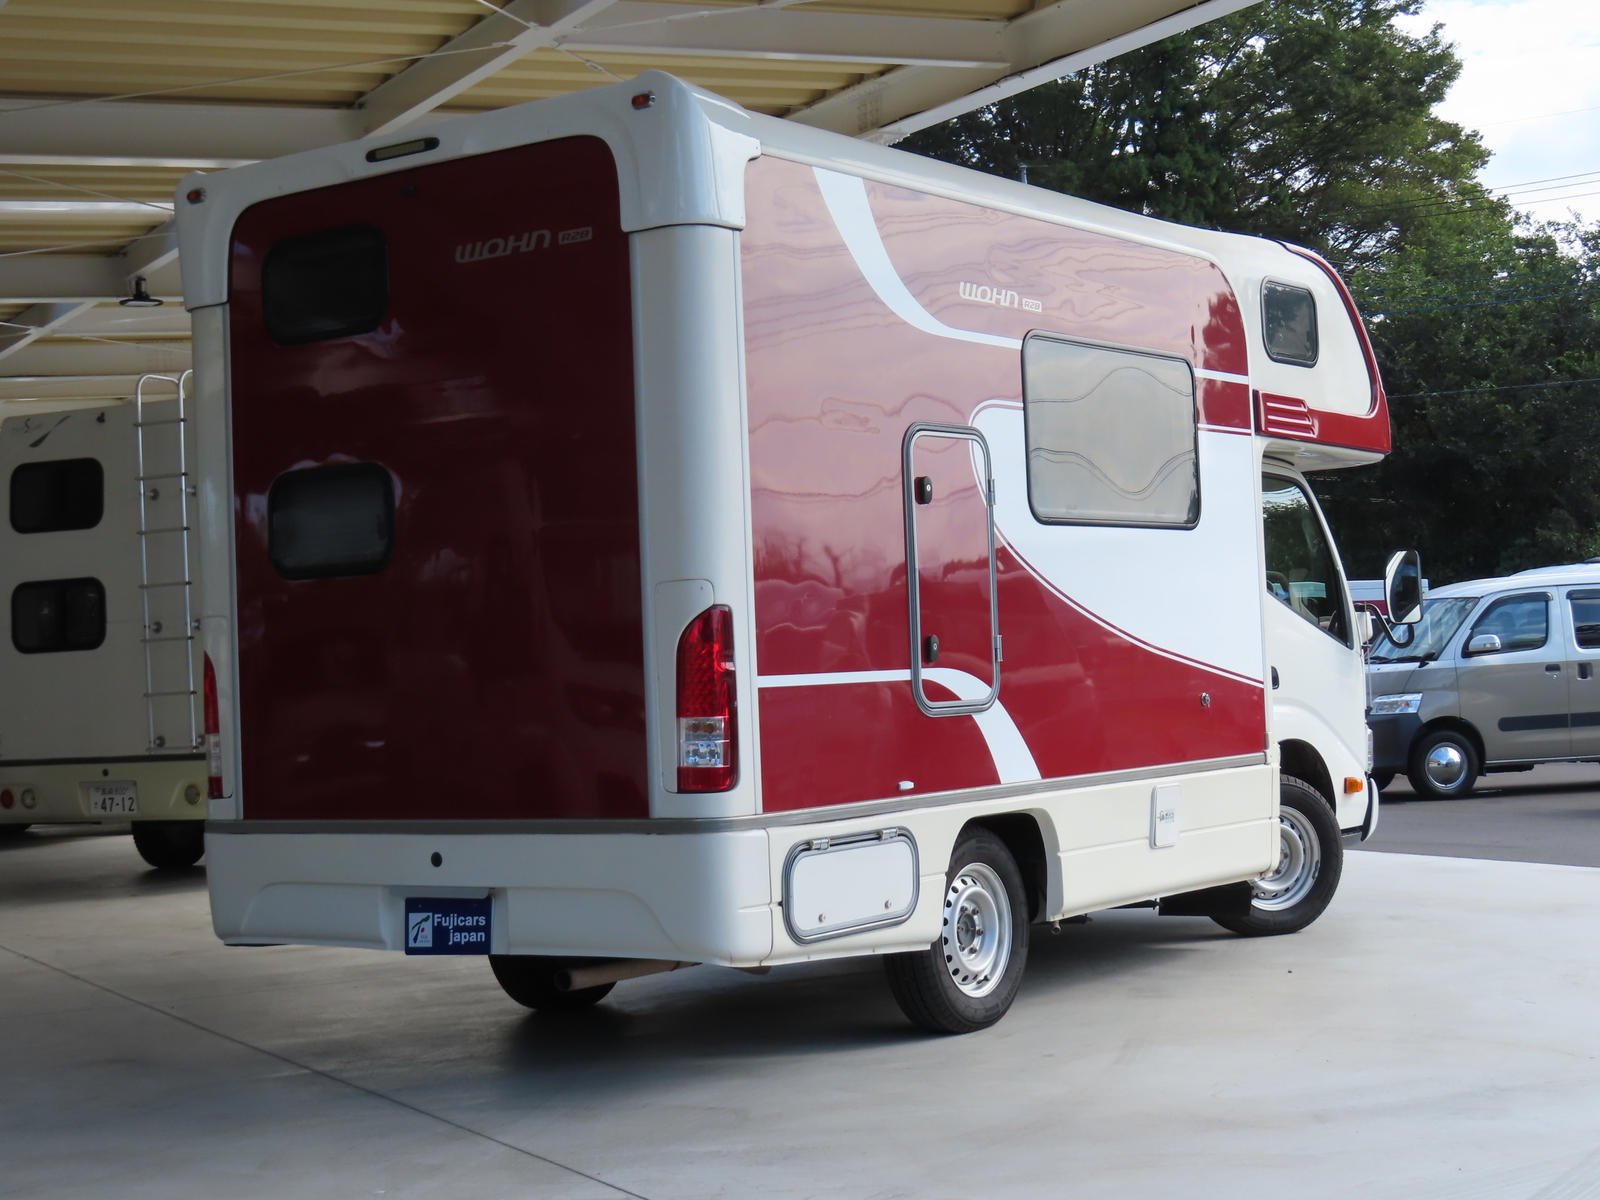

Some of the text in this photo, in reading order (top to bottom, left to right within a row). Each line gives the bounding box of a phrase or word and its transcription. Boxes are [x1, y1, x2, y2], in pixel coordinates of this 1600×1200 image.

[560, 229, 591, 243] R2B
[1024, 300, 1041, 311] R2B
[433, 914, 486, 929] Fujicars
[448, 930, 486, 945] japan
